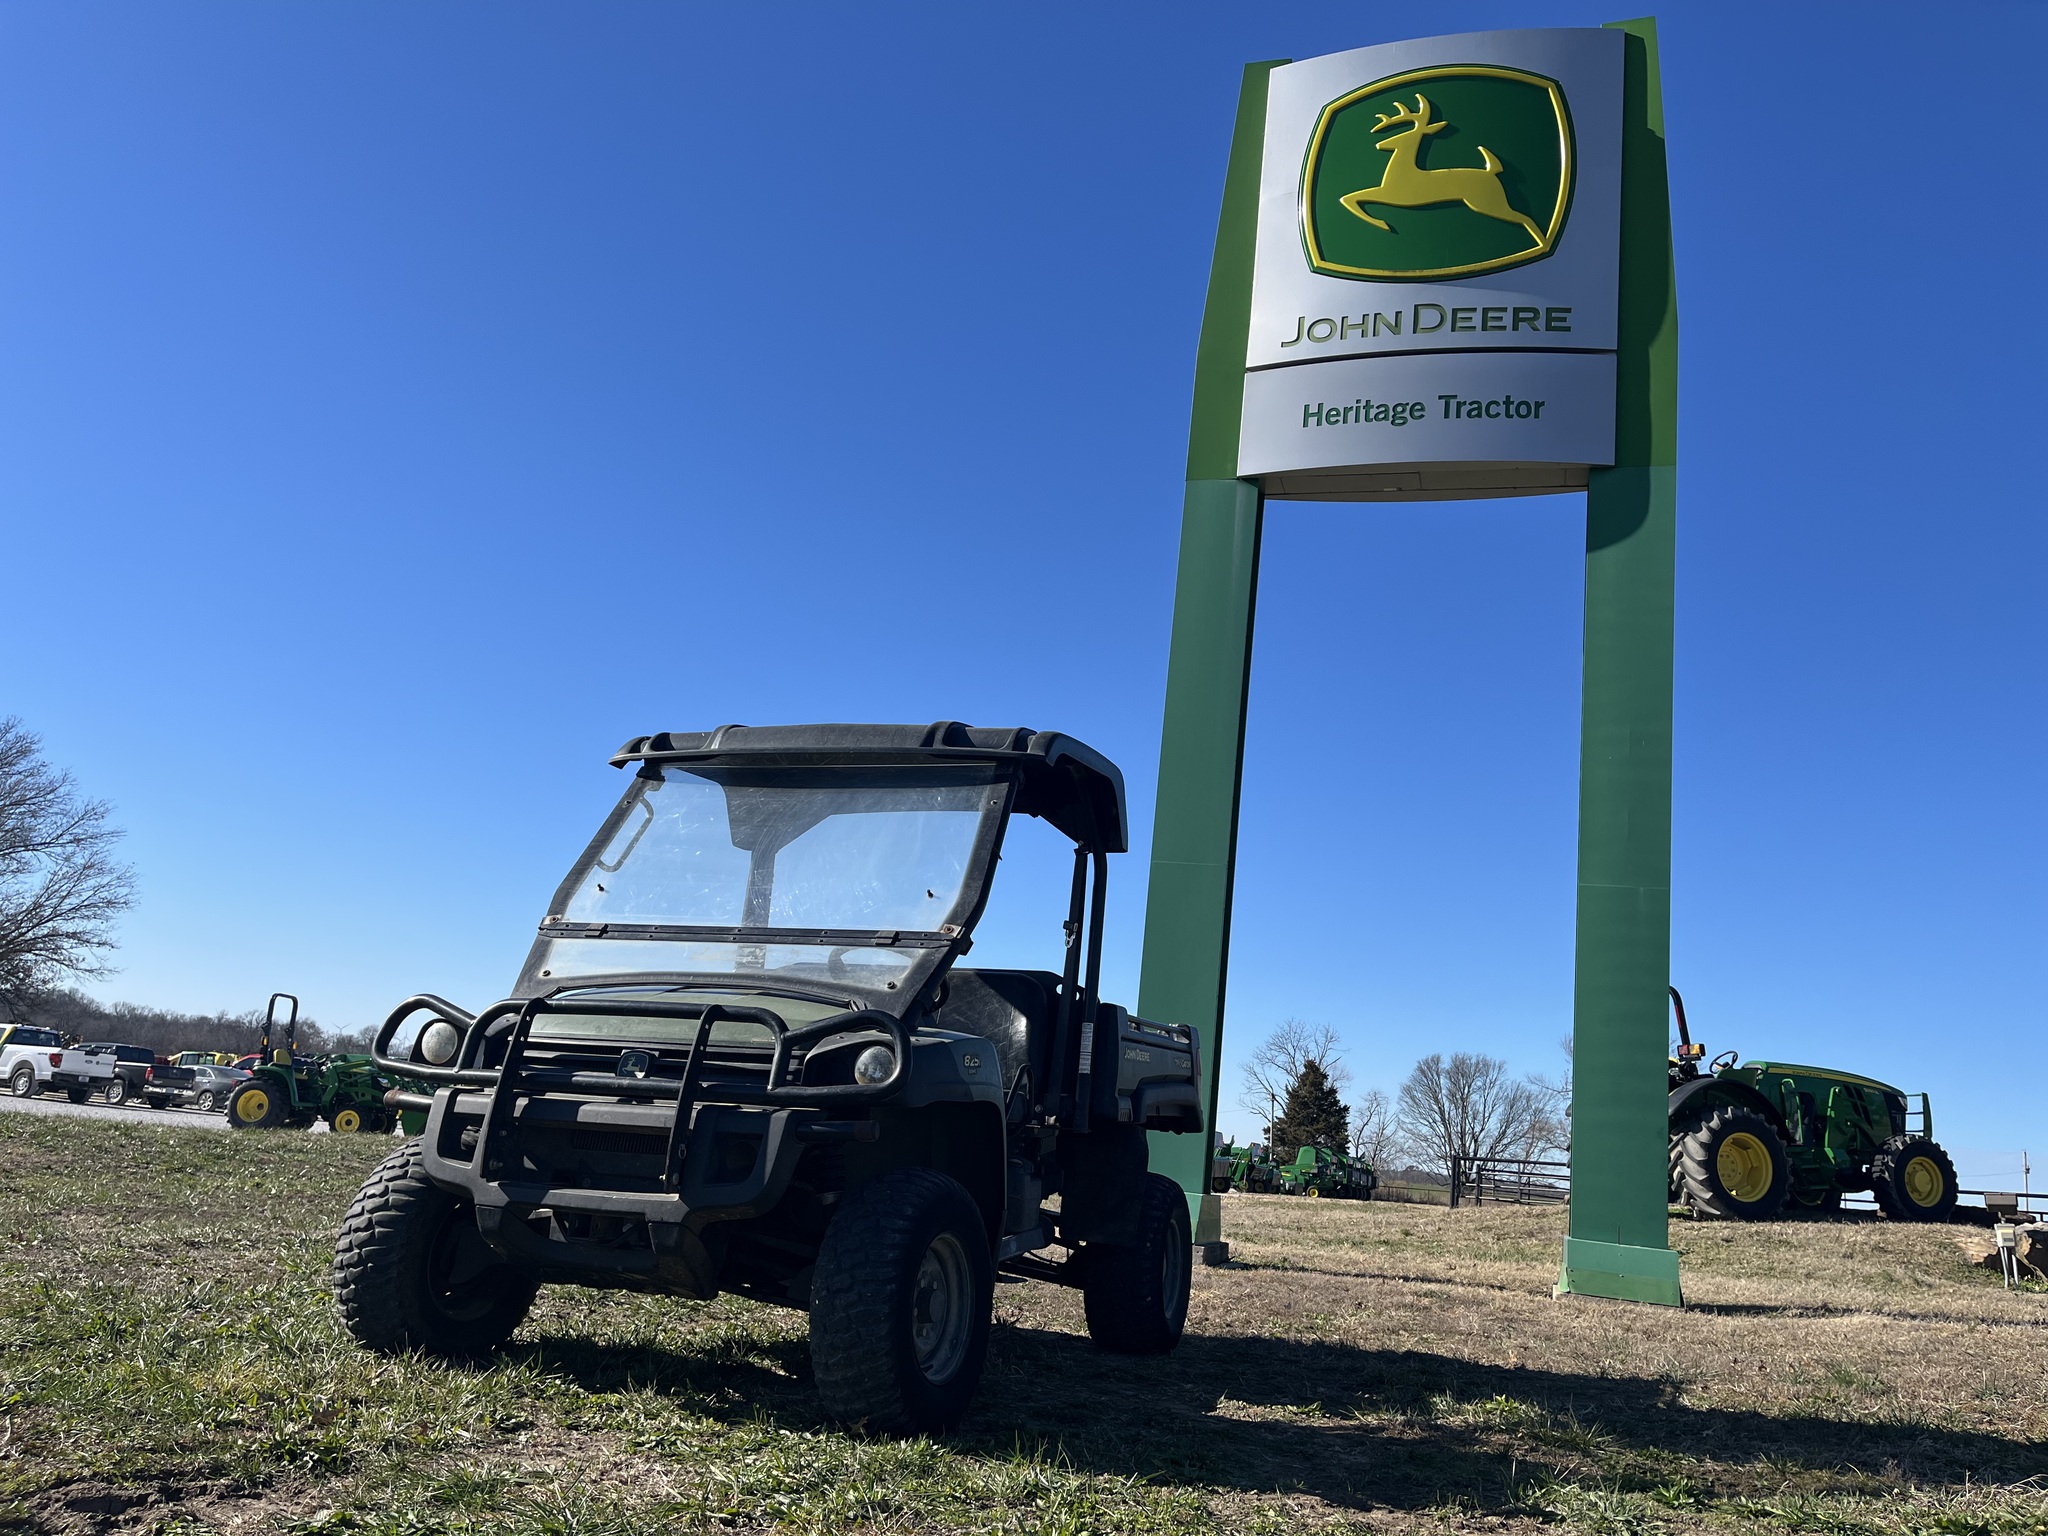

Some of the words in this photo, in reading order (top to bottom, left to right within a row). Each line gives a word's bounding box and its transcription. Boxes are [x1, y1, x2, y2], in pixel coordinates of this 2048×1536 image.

[1280, 310, 1403, 348] JOHN
[1412, 303, 1573, 334] DEERE
[1302, 399, 1426, 428] Heritage
[1438, 394, 1546, 420] Tractor
[1124, 1047, 1137, 1060] JOHN
[1137, 1049, 1151, 1062] DEERE
